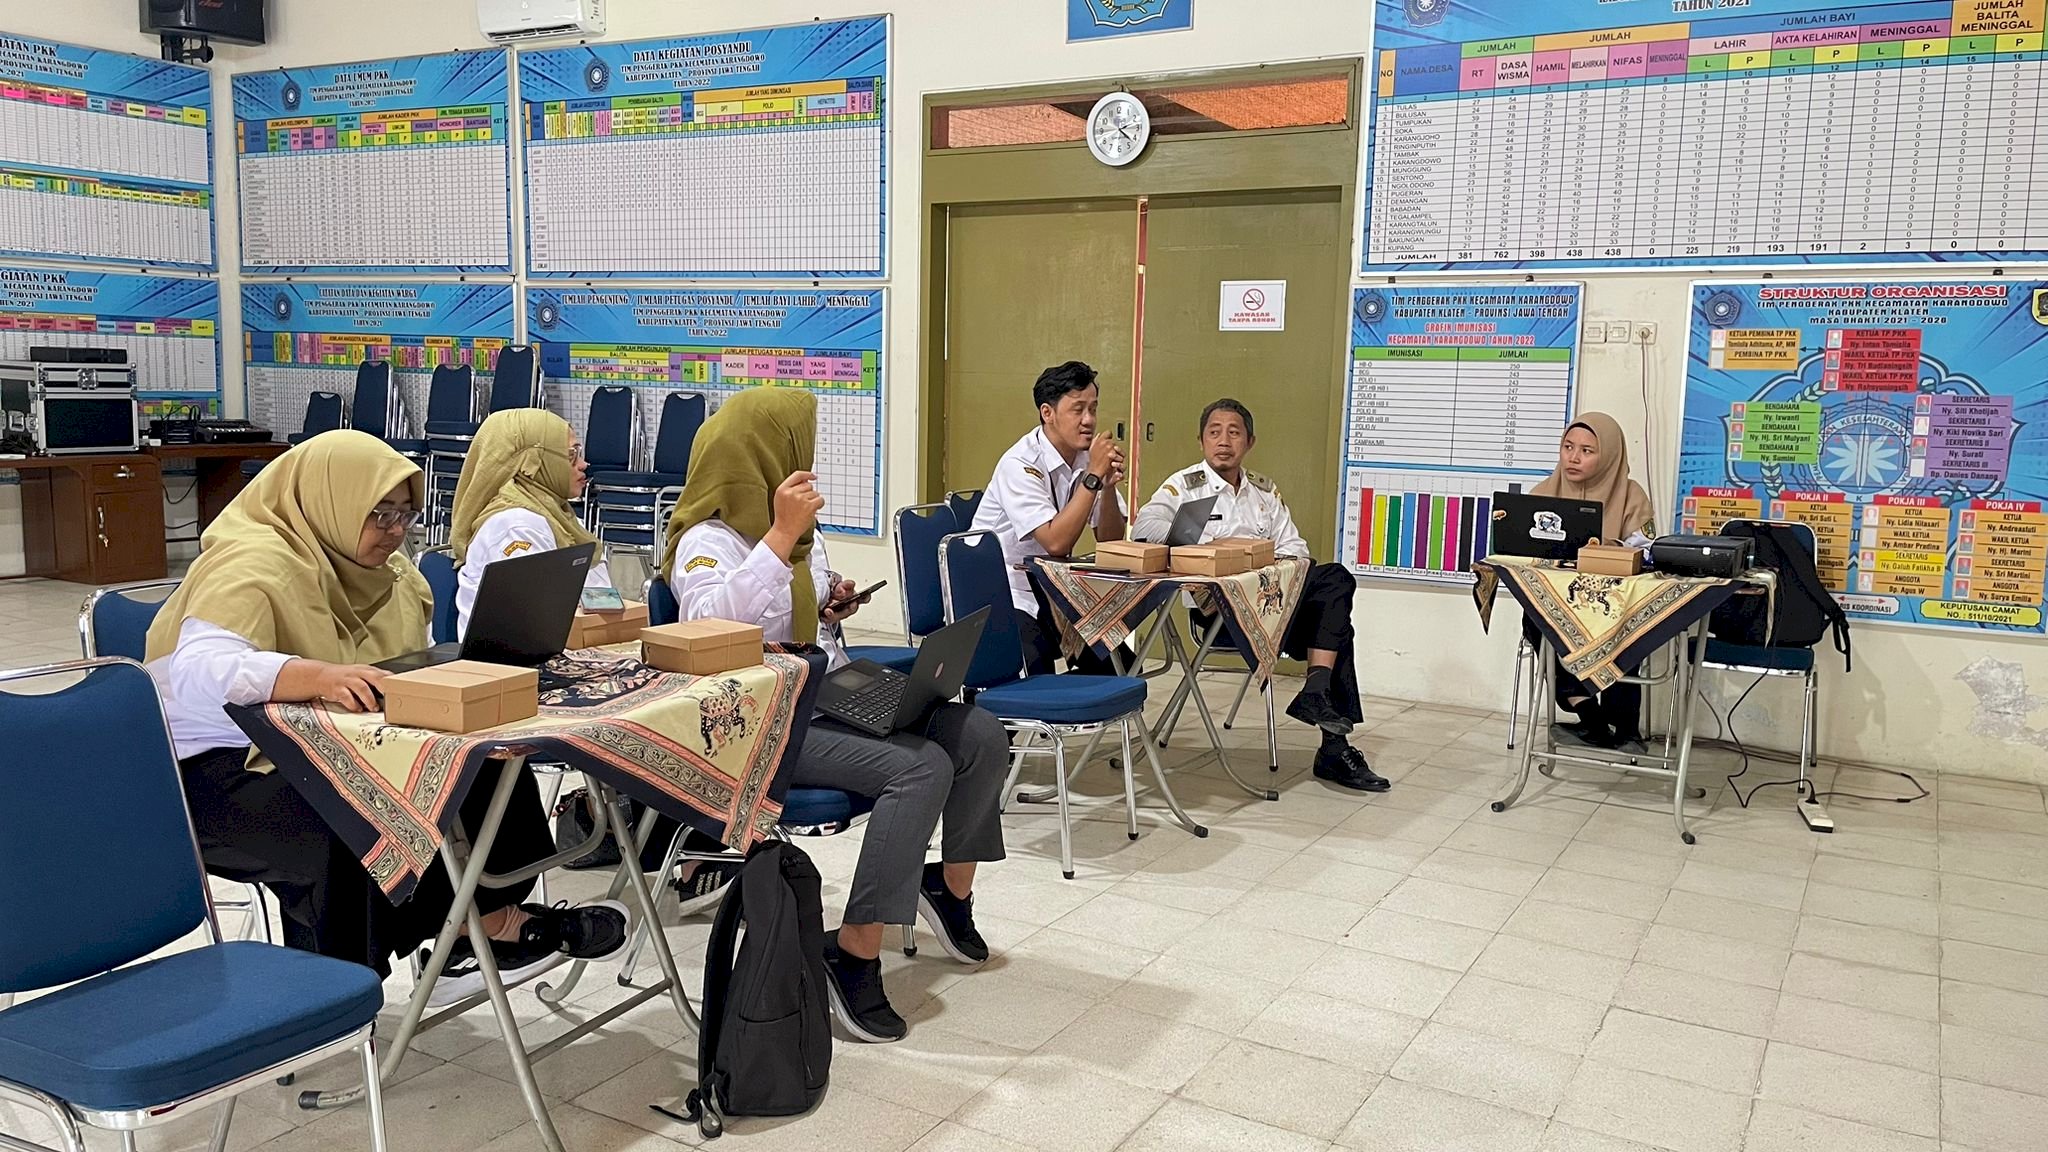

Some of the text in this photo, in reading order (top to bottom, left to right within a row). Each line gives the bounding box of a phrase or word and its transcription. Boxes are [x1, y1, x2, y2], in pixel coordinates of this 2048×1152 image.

[1673, 0, 1713, 11] TAHUN
[1974, 0, 2023, 10] JUMLAH
[1780, 13, 1855, 26] JUMLAH BAYI
[1977, 12, 2019, 20] BALITA
[1961, 21, 2033, 32] MENINGGAL
[1870, 26, 1940, 37] MENINGGAL
[1589, 32, 1631, 43] JUMLAH
[1775, 31, 1857, 44] AKTA KELAHIRAN
[1478, 42, 1516, 52] JUMLAH
[1714, 40, 1746, 49] LAHIR
[634, 42, 750, 62] DATA KEGIATAN POSYANDU
[1790, 53, 1795, 61] L
[1833, 50, 1839, 58] P
[1878, 47, 1883, 55] L
[1970, 41, 1976, 49] L
[1613, 57, 1642, 66] NIFAS
[1650, 53, 1685, 63] MENINGGAL
[37, 57, 88, 70] KARANGDOWO
[1501, 61, 1527, 70] DASA
[1536, 63, 1565, 72] HAMIL
[1572, 60, 1606, 69] MELAHIRKAN
[1401, 64, 1453, 76] NAMA DESA
[335, 73, 351, 83] DATA
[1497, 71, 1529, 80] WISMA
[1494, 251, 1509, 259] 762
[1530, 250, 1545, 258] 398
[1685, 246, 1699, 254] 225
[1727, 245, 1740, 254] 219
[1767, 244, 1784, 252] 193
[1809, 243, 1827, 251] 191
[1860, 242, 1866, 250] 2
[1905, 241, 1910, 249] 3
[1951, 240, 1957, 248] 0
[1998, 240, 2004, 248] 0
[44, 274, 66, 283] PKK
[1759, 286, 2006, 299] STRUKTUR ORGANISASI
[637, 295, 662, 304] JUMLAH
[664, 295, 695, 304] PETUGAS
[698, 295, 733, 305] POSYANDU
[743, 296, 770, 306] JUMLAH
[773, 296, 790, 306] BAYI
[793, 296, 816, 306] LAHIR
[826, 296, 870, 306] MENINGGAL
[1392, 295, 1573, 305] TIM PENGGERAK PKK KECAMATAN KARANGDOWO
[1395, 308, 1568, 317] KABUPATEN KLATEN PROVINSI JAWA TENGAH
[1425, 323, 1495, 332] GRAFIK IMUNISASI
[1388, 336, 1534, 345] KECAMATAN KARANGDOWO TAHUN 2022
[1796, 493, 1821, 501] POKJA
[1888, 497, 1915, 505] POKJA
[1986, 501, 2013, 510] POKJA
[1992, 559, 2025, 567] SEKRETARIS
[2007, 571, 2030, 579] Martini
[1993, 582, 2019, 590] ANGGOTA
[1852, 604, 1891, 613] KOORDINASI
[1941, 603, 2020, 614] KEPUTUSAN CAMAT
[1969, 613, 2011, 622] 511/10/2021
